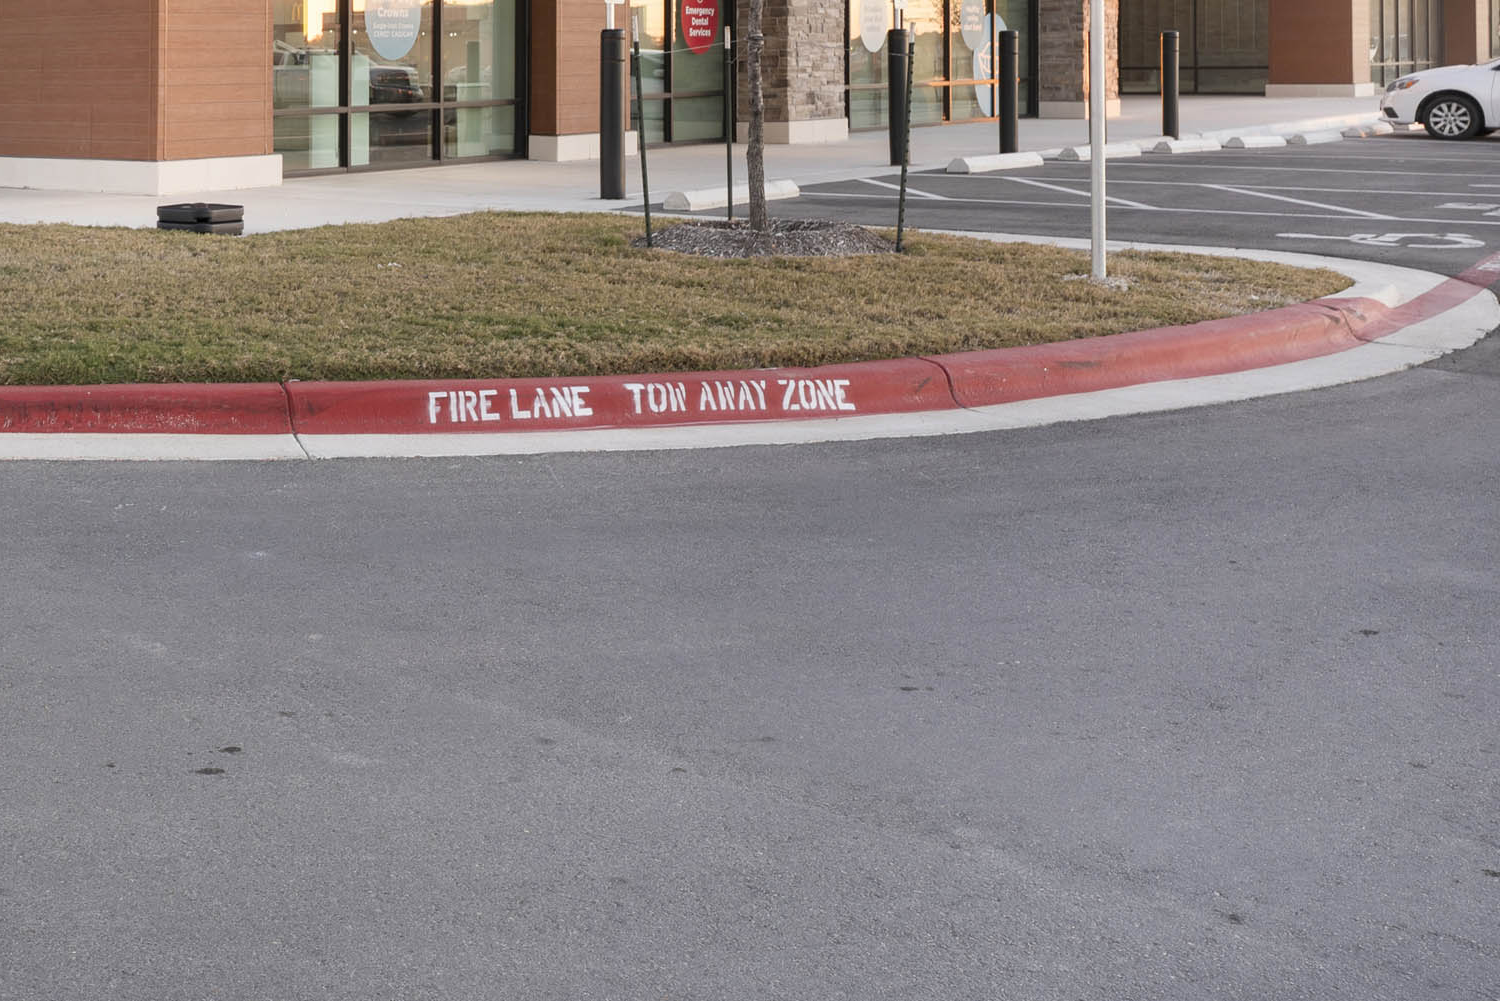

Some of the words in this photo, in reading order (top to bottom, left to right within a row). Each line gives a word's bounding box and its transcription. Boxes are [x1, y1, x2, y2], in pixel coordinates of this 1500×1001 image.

[685, 6, 715, 17] Emergency
[691, 17, 709, 26] Dental
[688, 27, 712, 37] Services
[428, 389, 500, 424] FIRE
[509, 386, 593, 419] LANE
[622, 381, 687, 414] TOW
[700, 380, 767, 411] AWAY
[777, 379, 857, 411] ZONE
